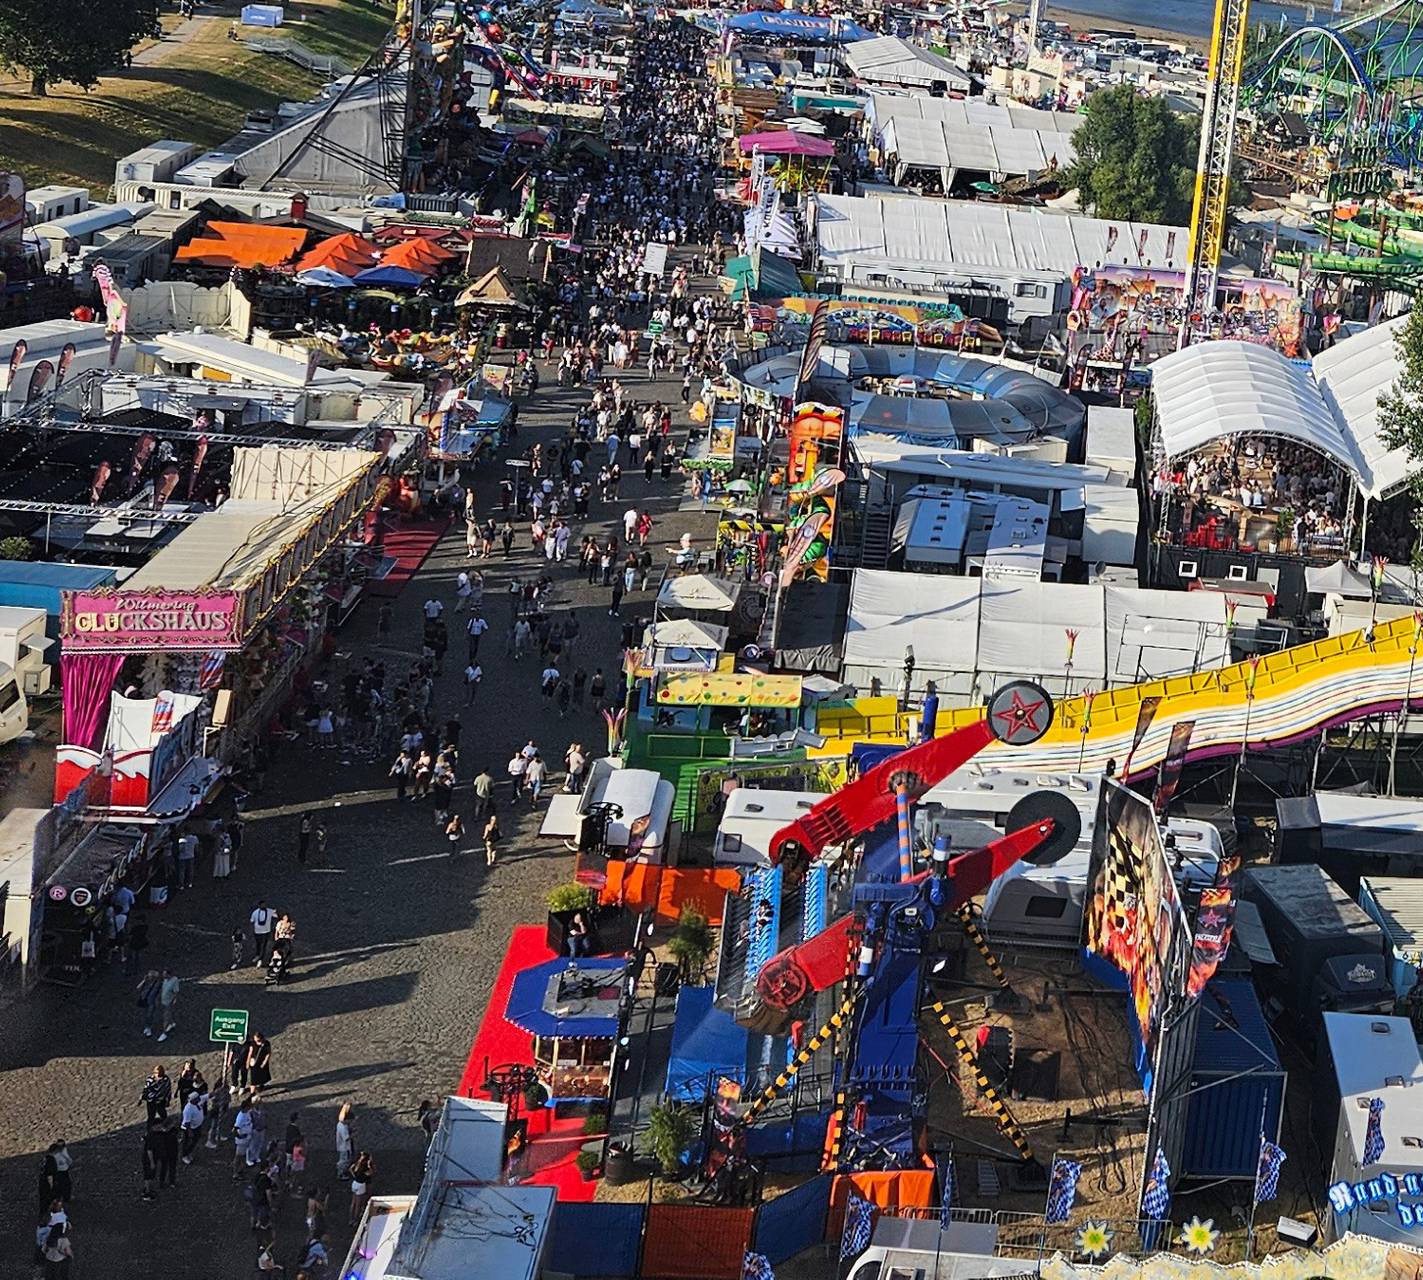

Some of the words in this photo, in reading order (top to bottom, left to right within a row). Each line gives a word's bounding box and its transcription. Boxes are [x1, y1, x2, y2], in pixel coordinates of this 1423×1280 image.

[214, 1016, 245, 1025] Ausgang
[222, 1022, 236, 1030] Exit
[1329, 1173, 1399, 1214] Rund
